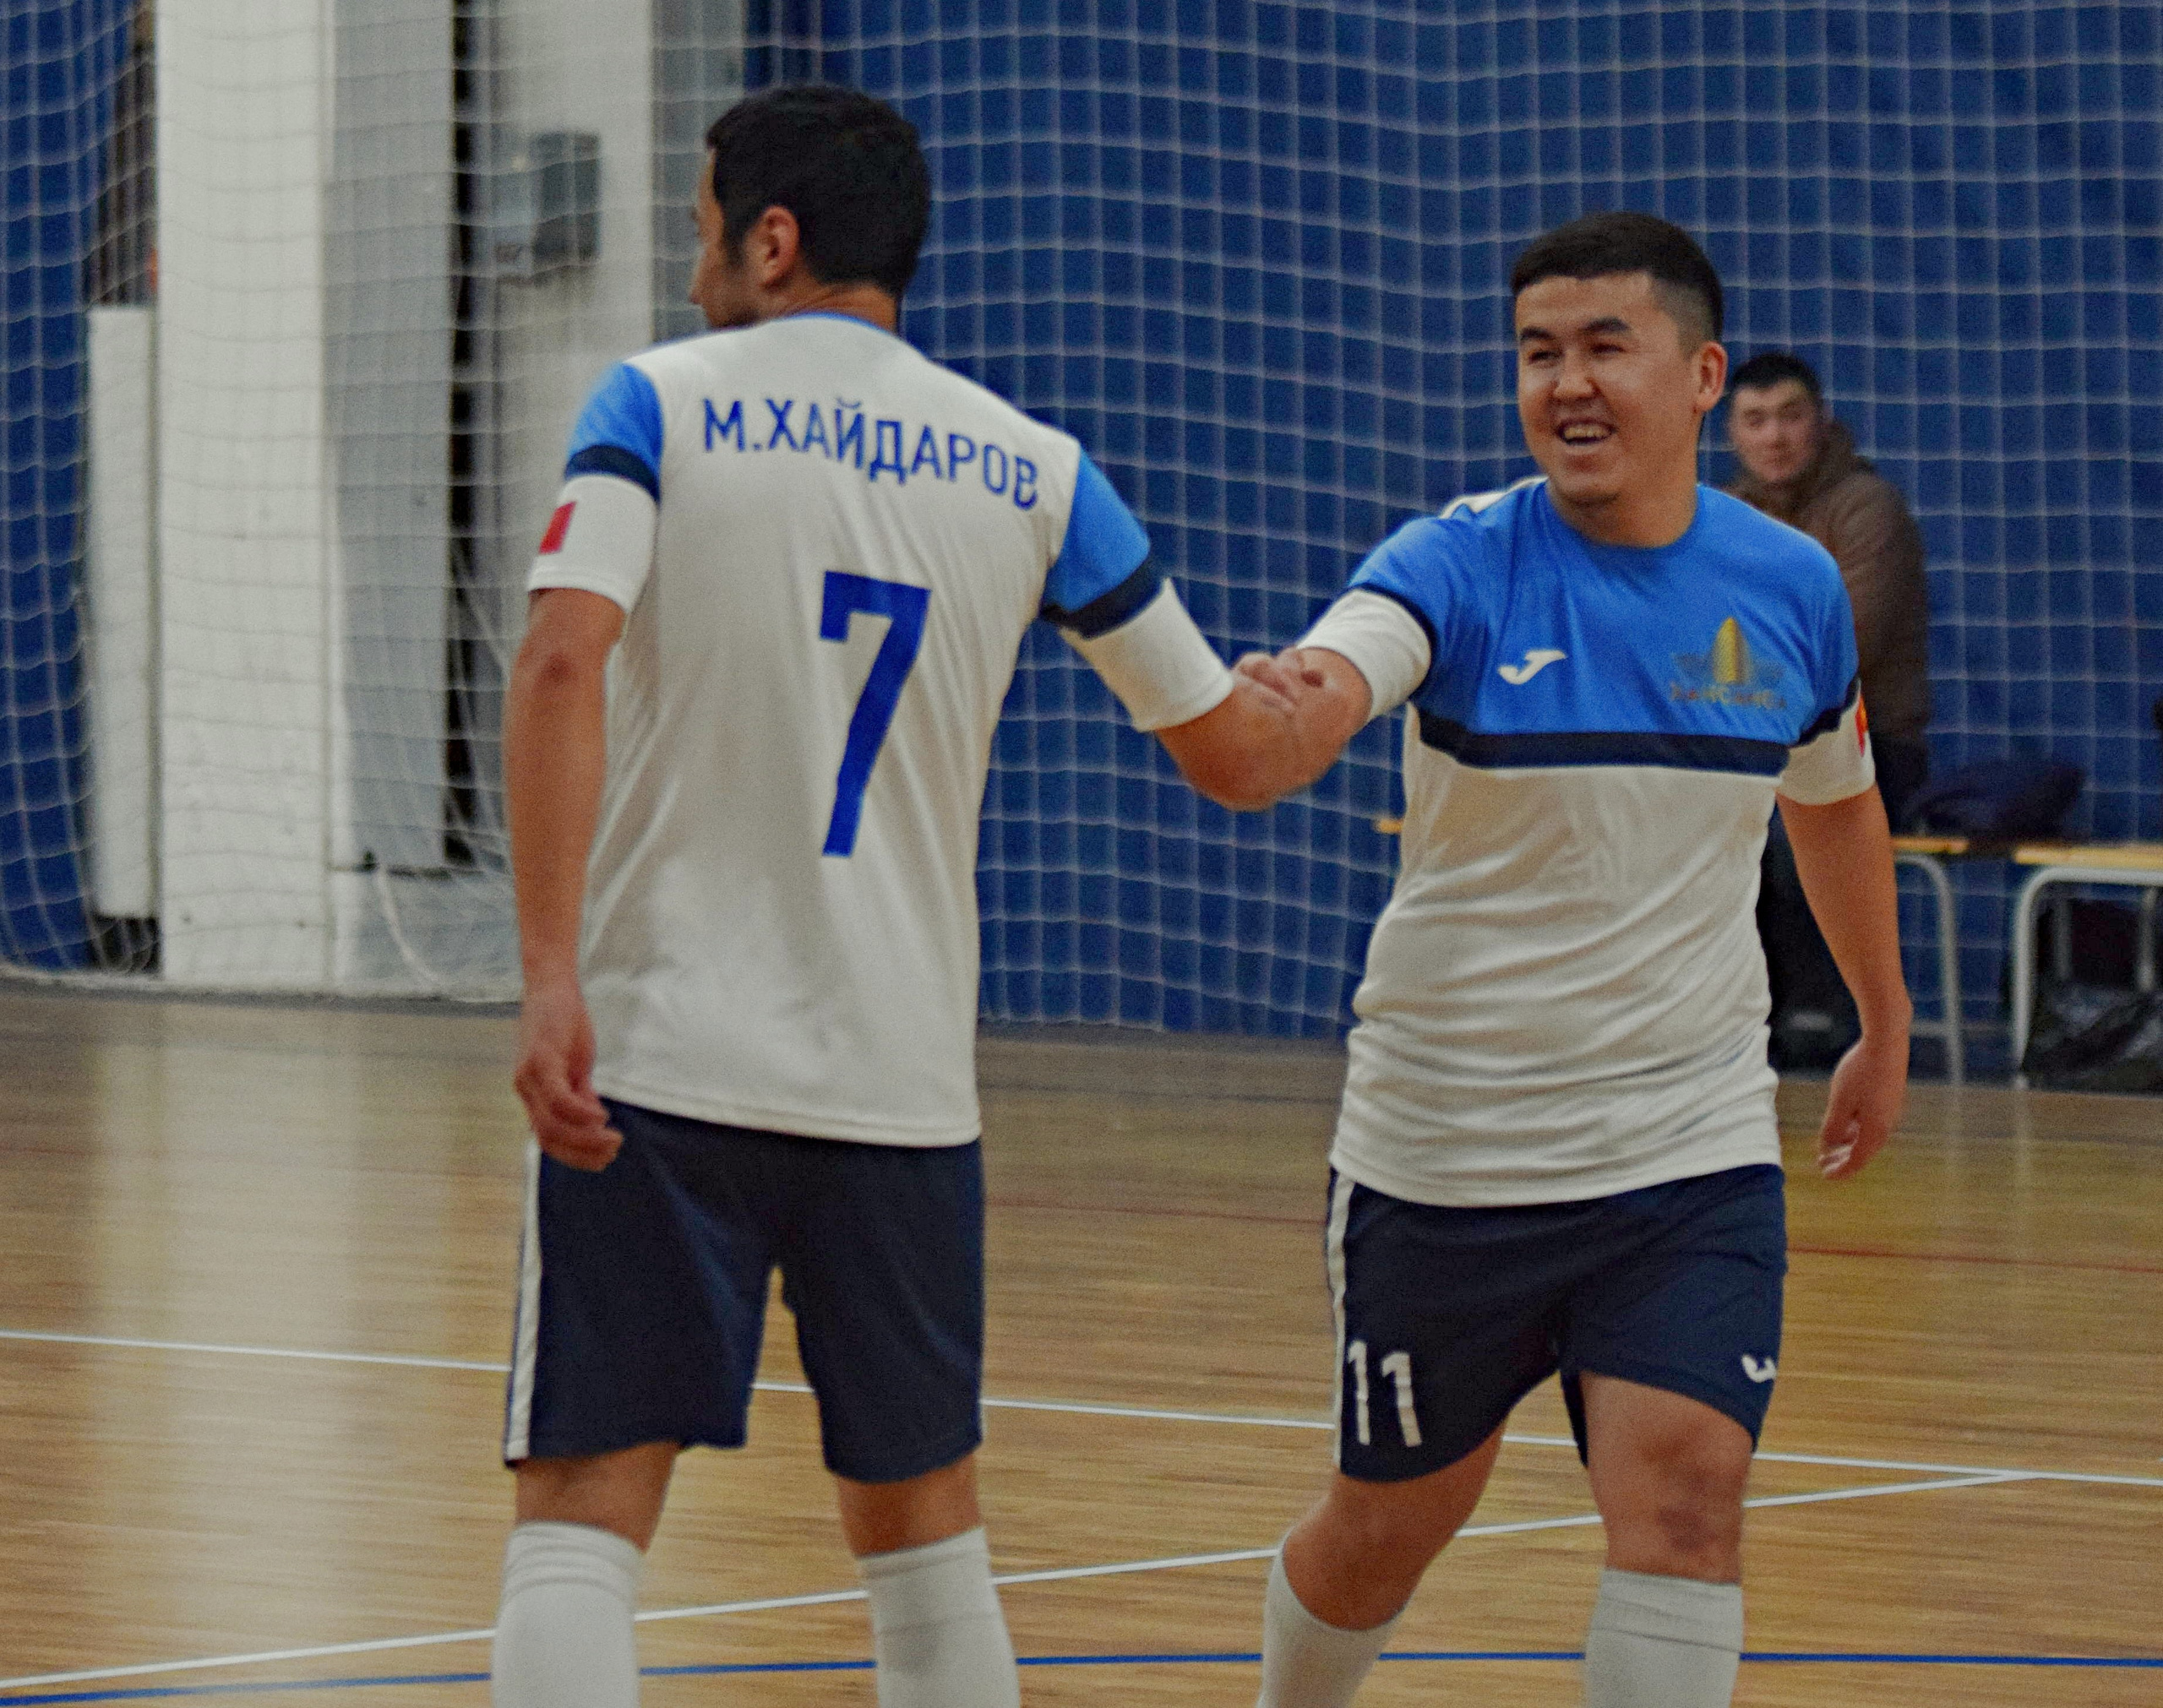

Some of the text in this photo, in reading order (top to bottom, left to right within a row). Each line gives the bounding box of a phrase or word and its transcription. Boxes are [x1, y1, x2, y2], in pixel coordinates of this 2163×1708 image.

[703, 397, 1038, 511] М.ХАЙДАРОВ
[820, 570, 931, 858] 7
[1348, 1340, 1423, 1447] 11
